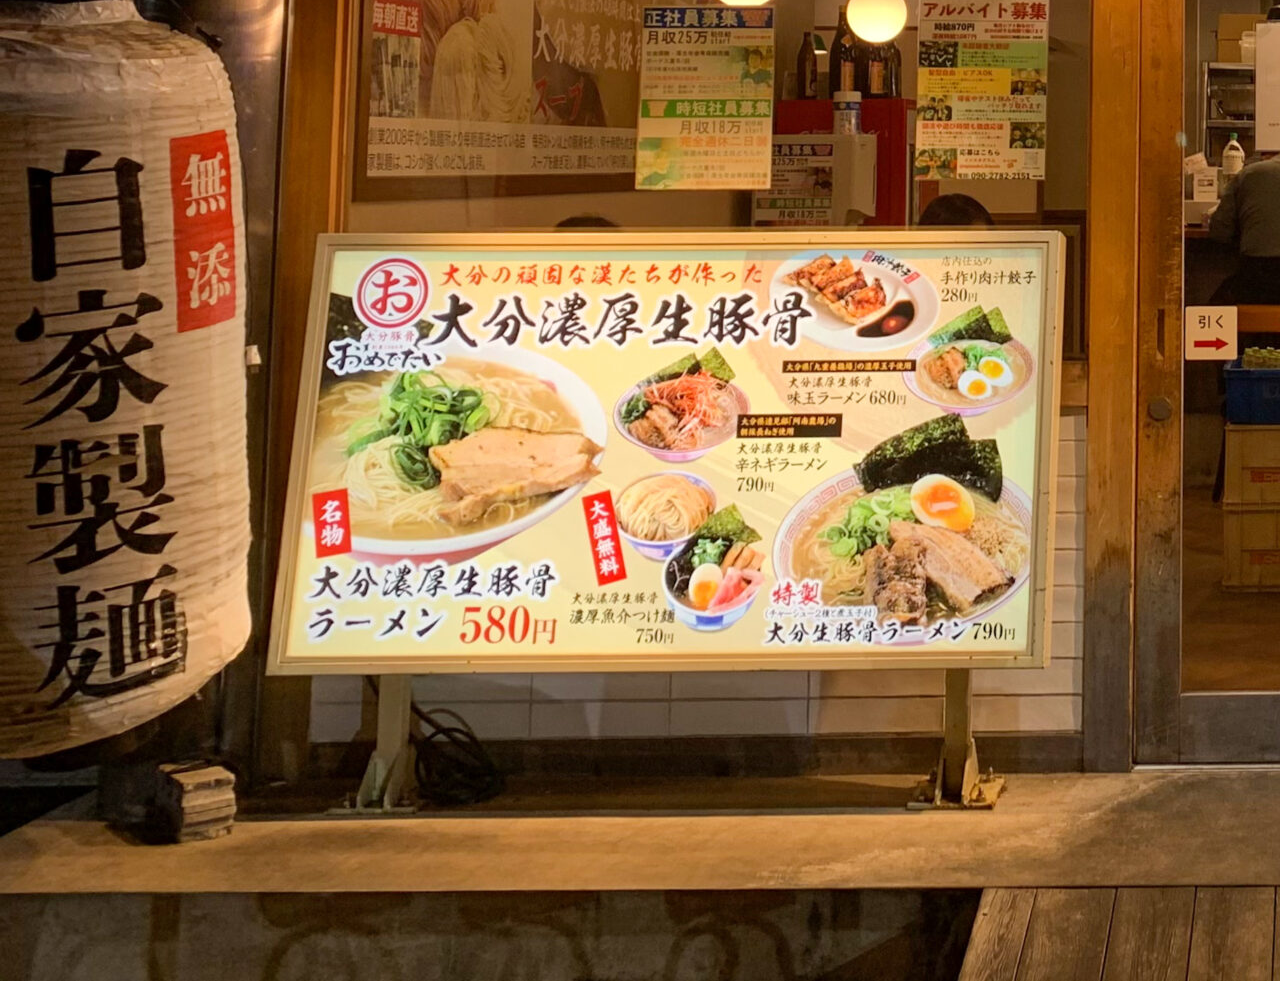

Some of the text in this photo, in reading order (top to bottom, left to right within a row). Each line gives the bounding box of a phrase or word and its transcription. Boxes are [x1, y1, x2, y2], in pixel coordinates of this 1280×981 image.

[372, 0, 420, 33] 毎朝直送
[645, 9, 738, 27] 正社員募集
[923, 2, 1047, 20] アルバイト募集
[647, 30, 708, 45] 月収25万
[676, 100, 770, 116] 時短社員募集
[680, 120, 742, 135] 月収18万
[180, 153, 232, 310] 無添
[438, 262, 763, 287] 大分の頑固な漢たちが作った
[940, 270, 1037, 286] 手作り肉汁餃子
[370, 269, 419, 315] お
[940, 288, 978, 303] 280円
[424, 291, 813, 348] 大分濃厚生豚骨
[1198, 315, 1224, 329] 引く
[786, 389, 907, 406] 味玉ラーメン 680円
[14, 147, 188, 711] 自家製麺
[736, 457, 828, 473] 辛ネギラーメン
[736, 476, 775, 493] 790円
[319, 499, 346, 548] 名物
[588, 500, 621, 577] 大盛無料
[309, 563, 557, 599] 大分濃厚生豚骨
[771, 582, 822, 607] 特製
[308, 604, 558, 646] ラーメン 580円
[569, 609, 676, 625] 濃厚魚介つけ麺
[635, 628, 675, 645] 750円
[764, 621, 1016, 646] 大分生豚骨ラーメン 790円
